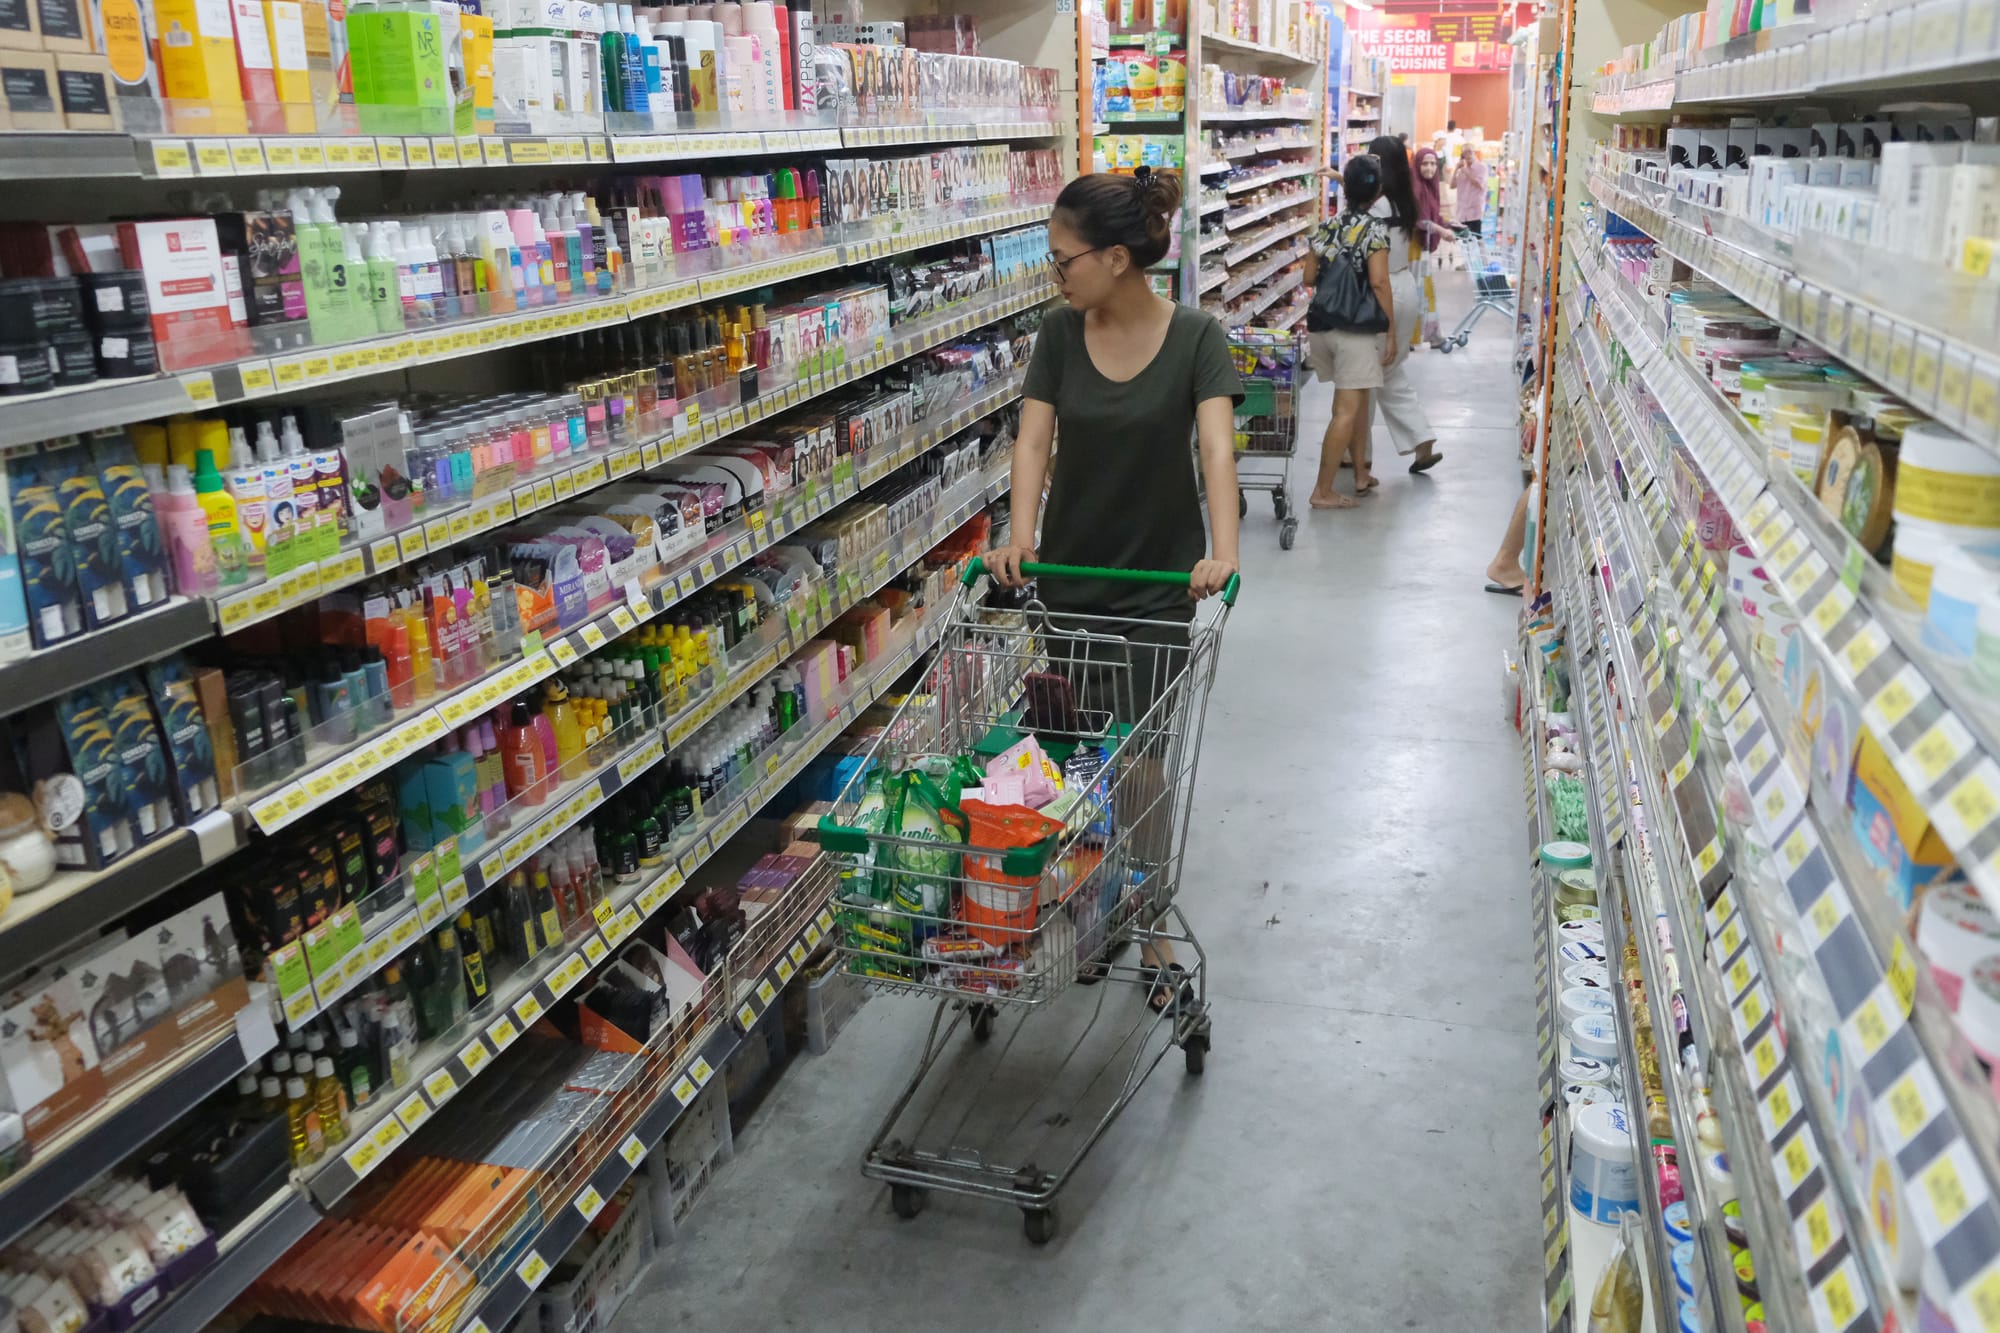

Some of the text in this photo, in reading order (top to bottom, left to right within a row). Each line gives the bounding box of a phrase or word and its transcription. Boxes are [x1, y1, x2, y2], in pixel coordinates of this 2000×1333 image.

[1057, 0, 1071, 11] 35
[1364, 44, 1447, 57] AUTHENTIC
[1390, 57, 1447, 71] CUISINE
[332, 264, 347, 287] 3
[378, 287, 387, 299] 3
